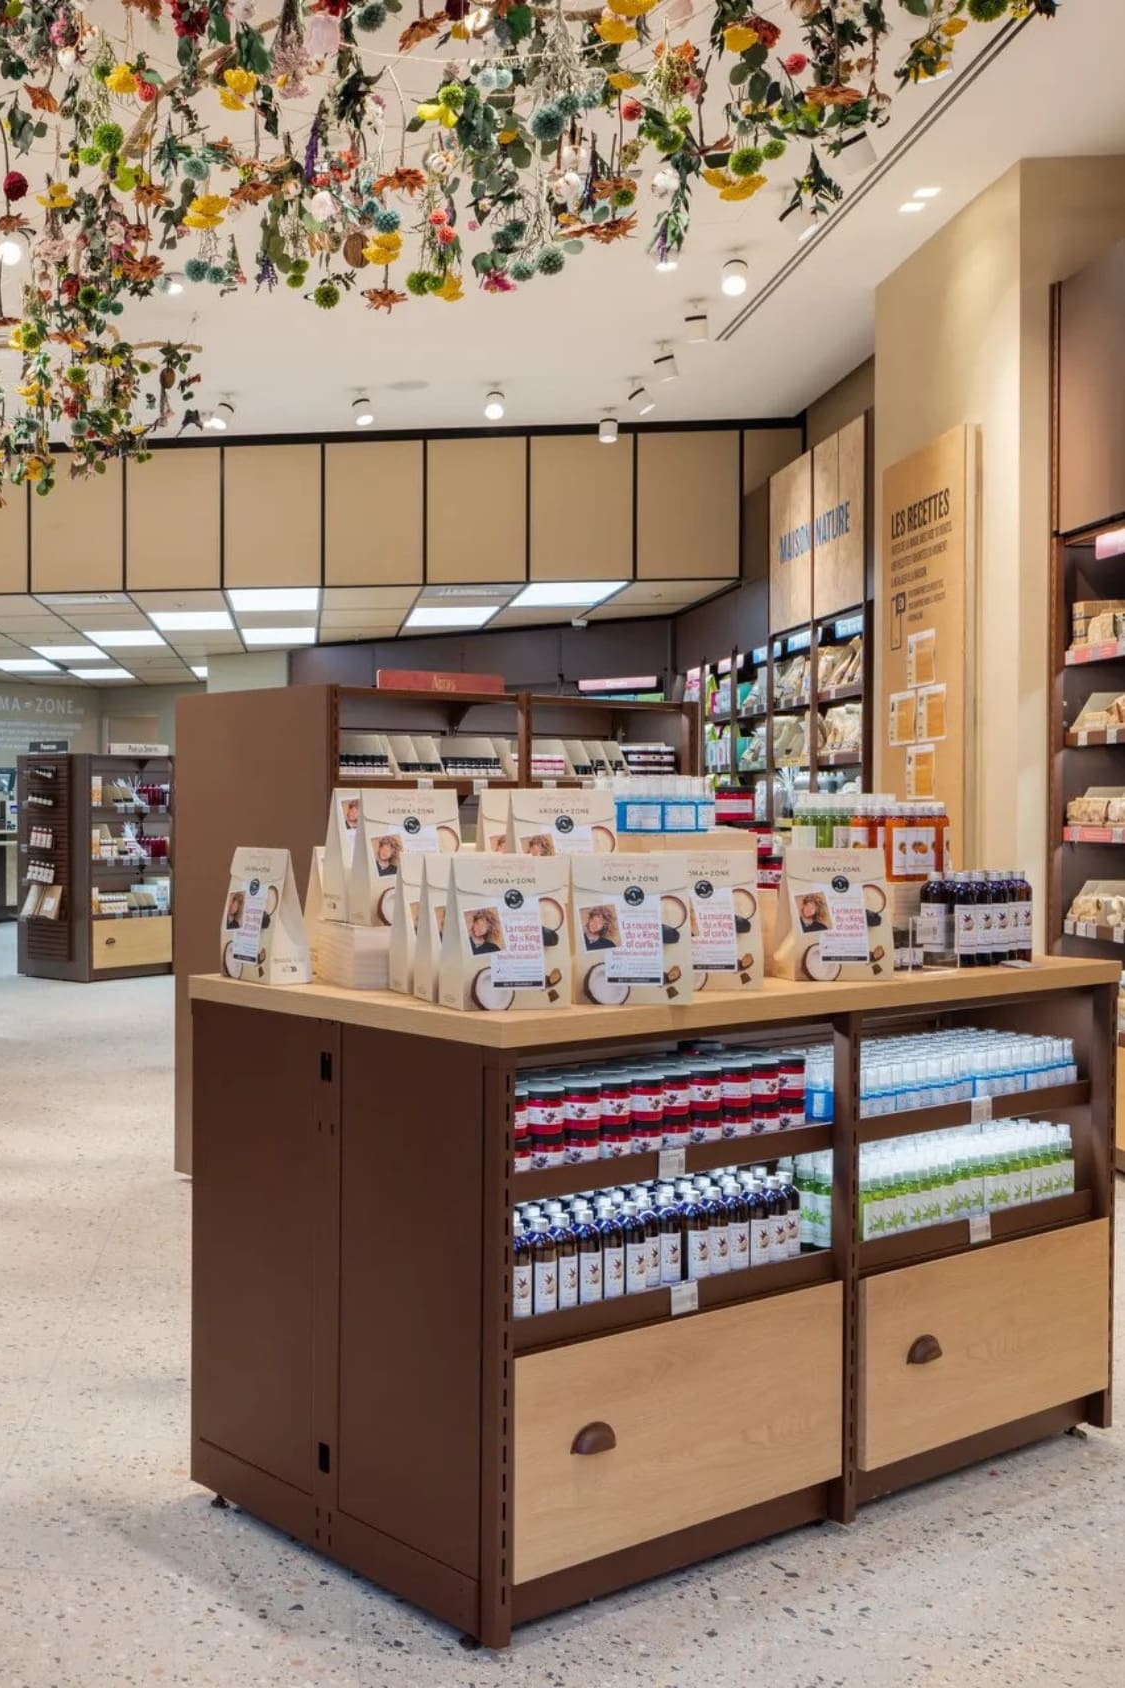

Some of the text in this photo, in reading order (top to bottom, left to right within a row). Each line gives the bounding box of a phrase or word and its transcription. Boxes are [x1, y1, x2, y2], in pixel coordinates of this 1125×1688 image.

[890, 508, 906, 540] LES
[907, 487, 950, 533] RECETTES
[779, 522, 812, 565] MAISON
[815, 501, 850, 548] NATURE
[35, 697, 75, 714] ZONE
[482, 877, 536, 885] AROMA ZONE
[602, 875, 660, 883] AROMA ZONE
[643, 931, 660, 941] King
